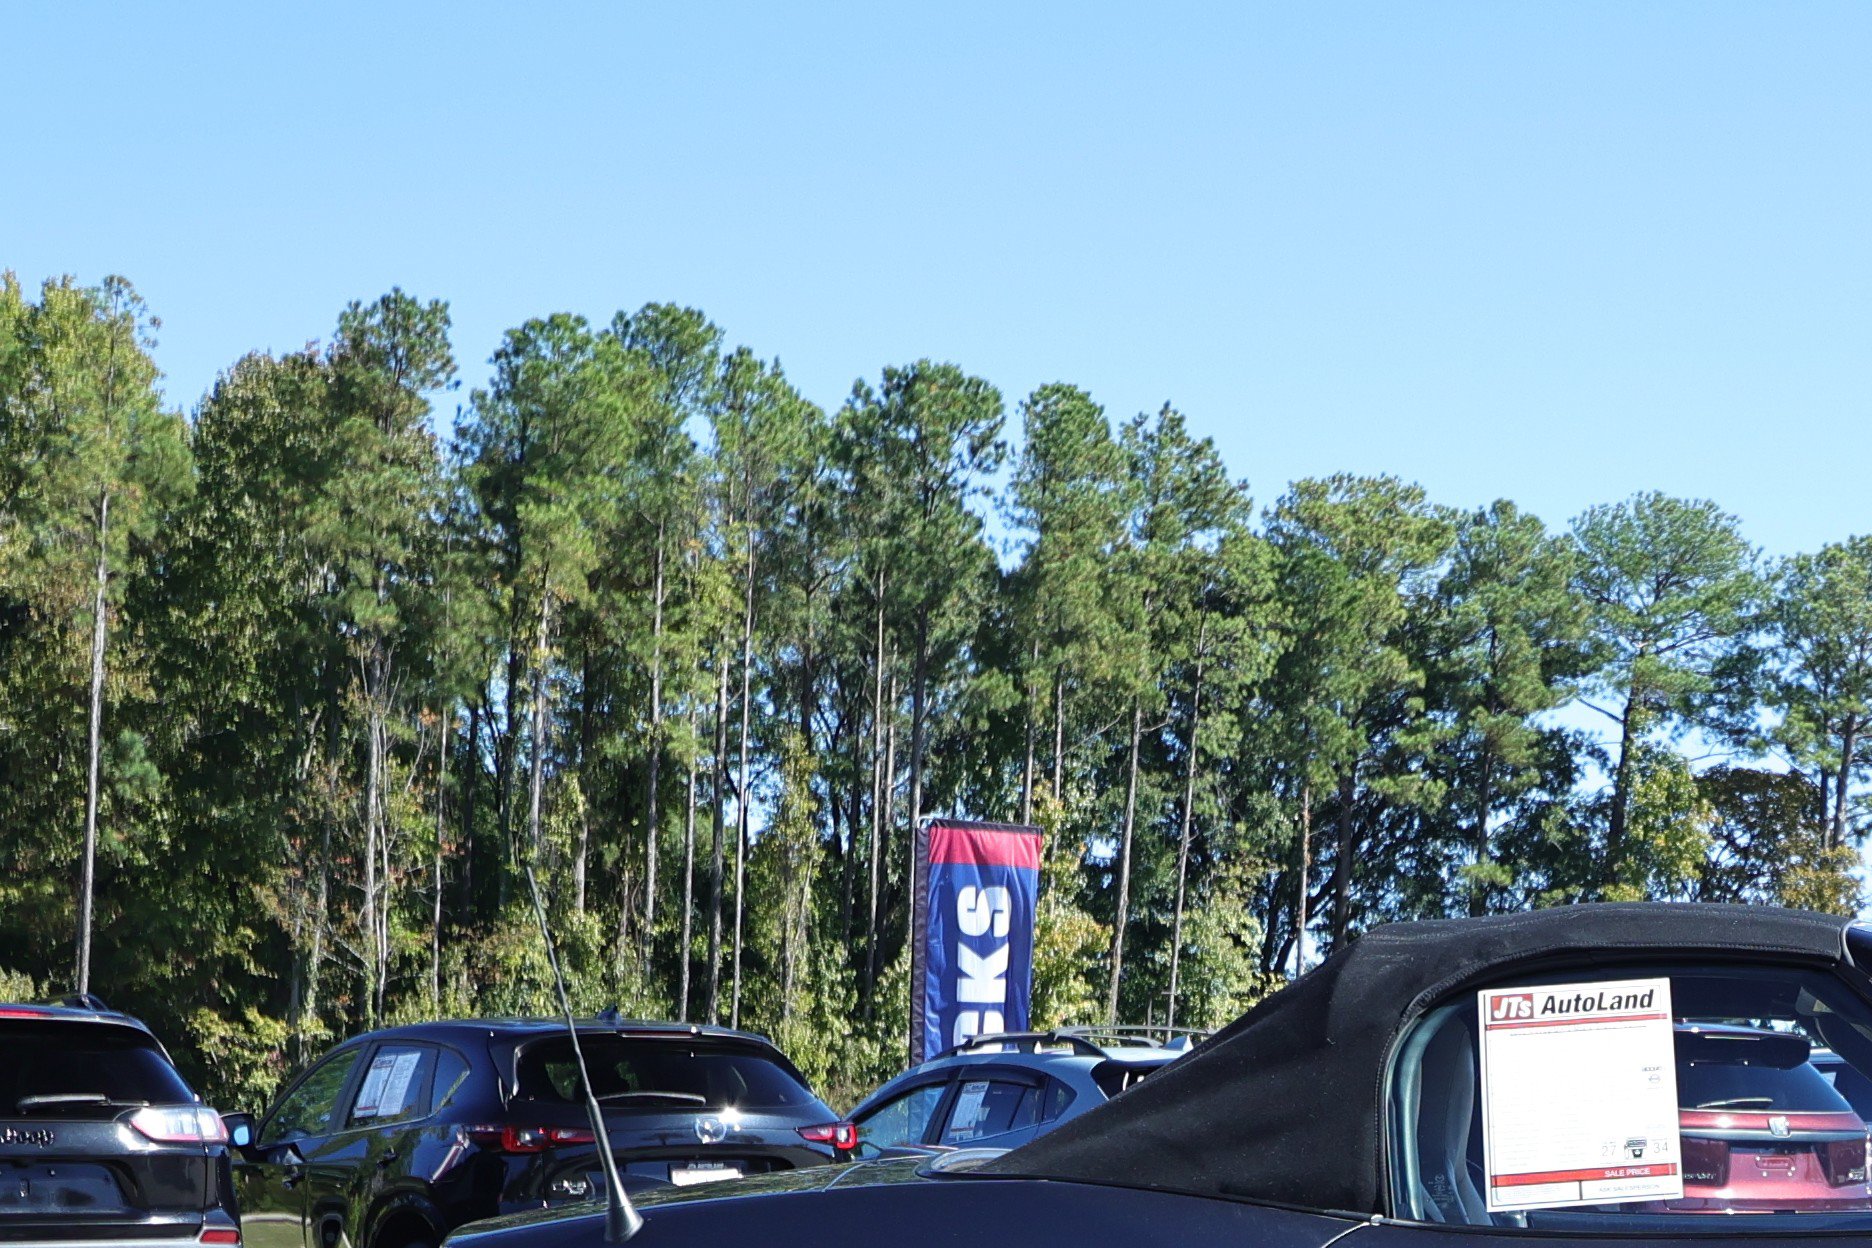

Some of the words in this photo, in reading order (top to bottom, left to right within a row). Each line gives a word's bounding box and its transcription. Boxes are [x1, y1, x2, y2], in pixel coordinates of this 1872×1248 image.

[1493, 995, 1533, 1019] JTs
[1541, 989, 1655, 1015] AutoLand
[1602, 1145, 1617, 1156] 27
[1653, 1142, 1668, 1153] 34
[1627, 1168, 1650, 1176] PRICE
